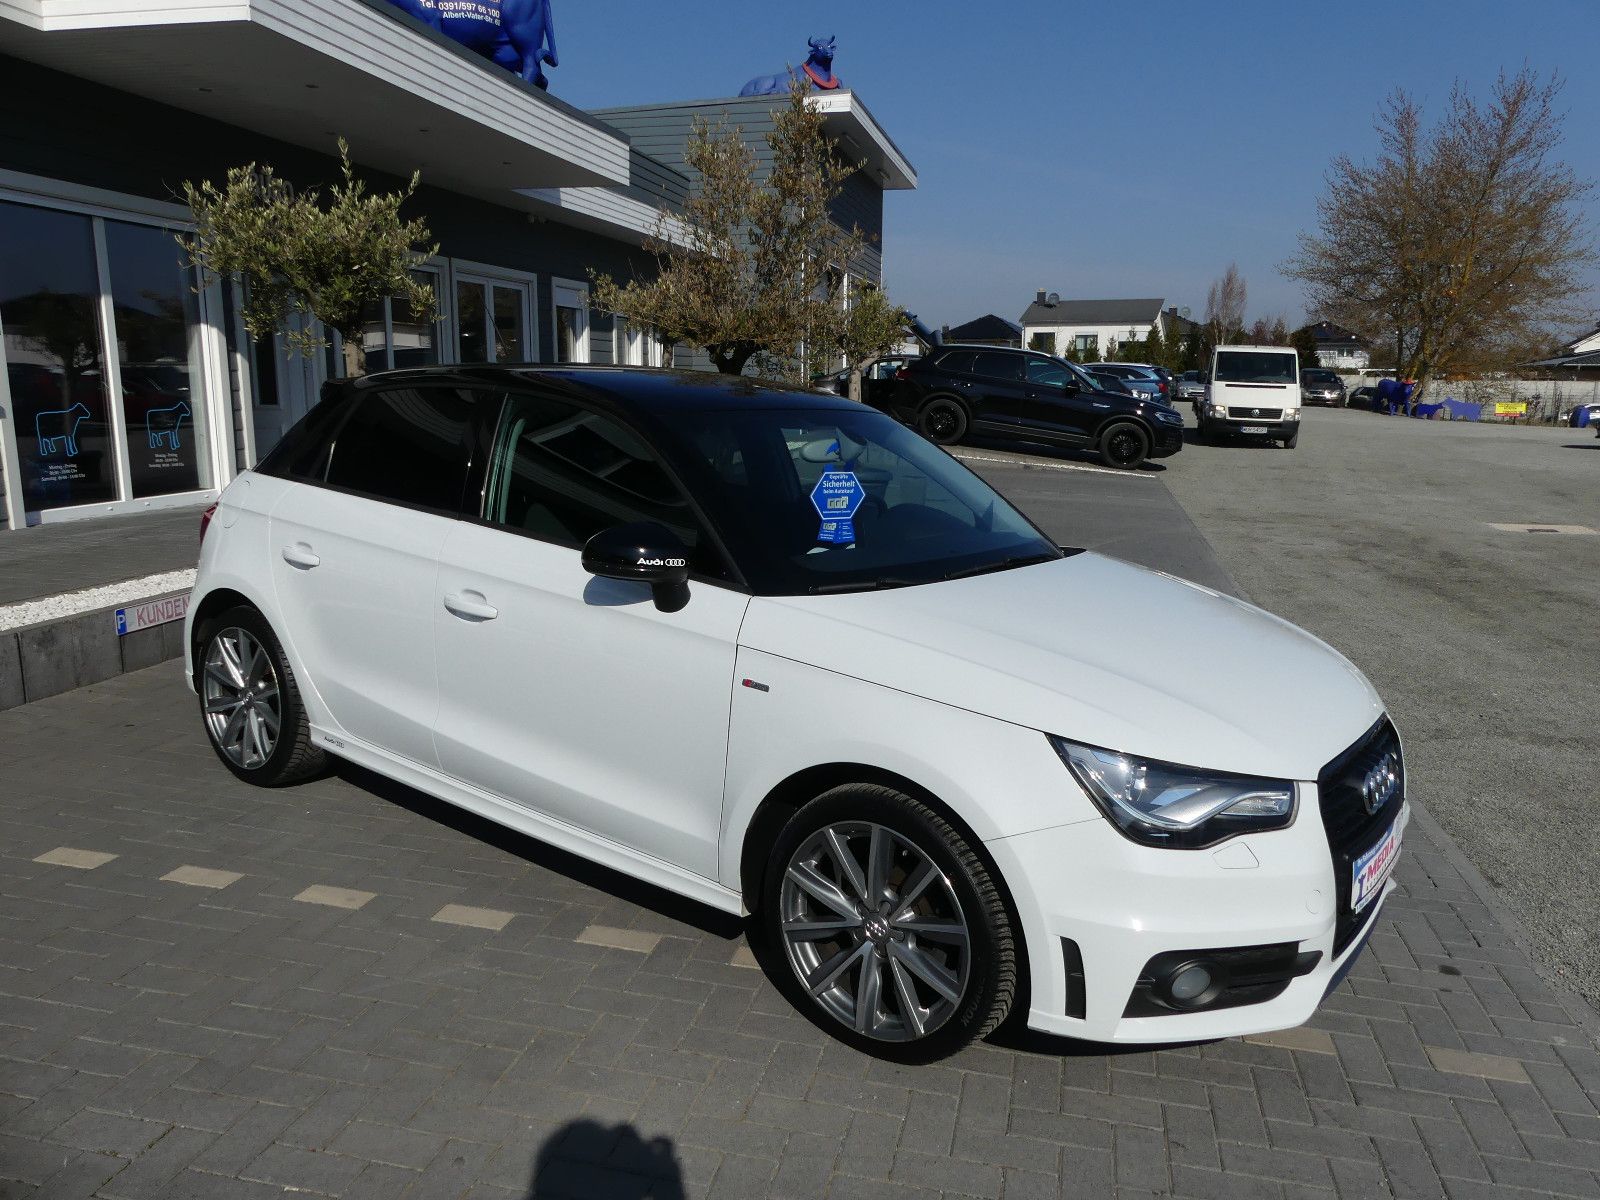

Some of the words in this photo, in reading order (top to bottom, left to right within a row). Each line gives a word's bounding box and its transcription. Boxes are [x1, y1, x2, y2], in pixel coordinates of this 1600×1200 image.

[438, 2, 476, 11] 0391/597
[822, 480, 856, 488] Sicherheit
[636, 557, 664, 566] Audi
[136, 595, 190, 627] KUNDEN
